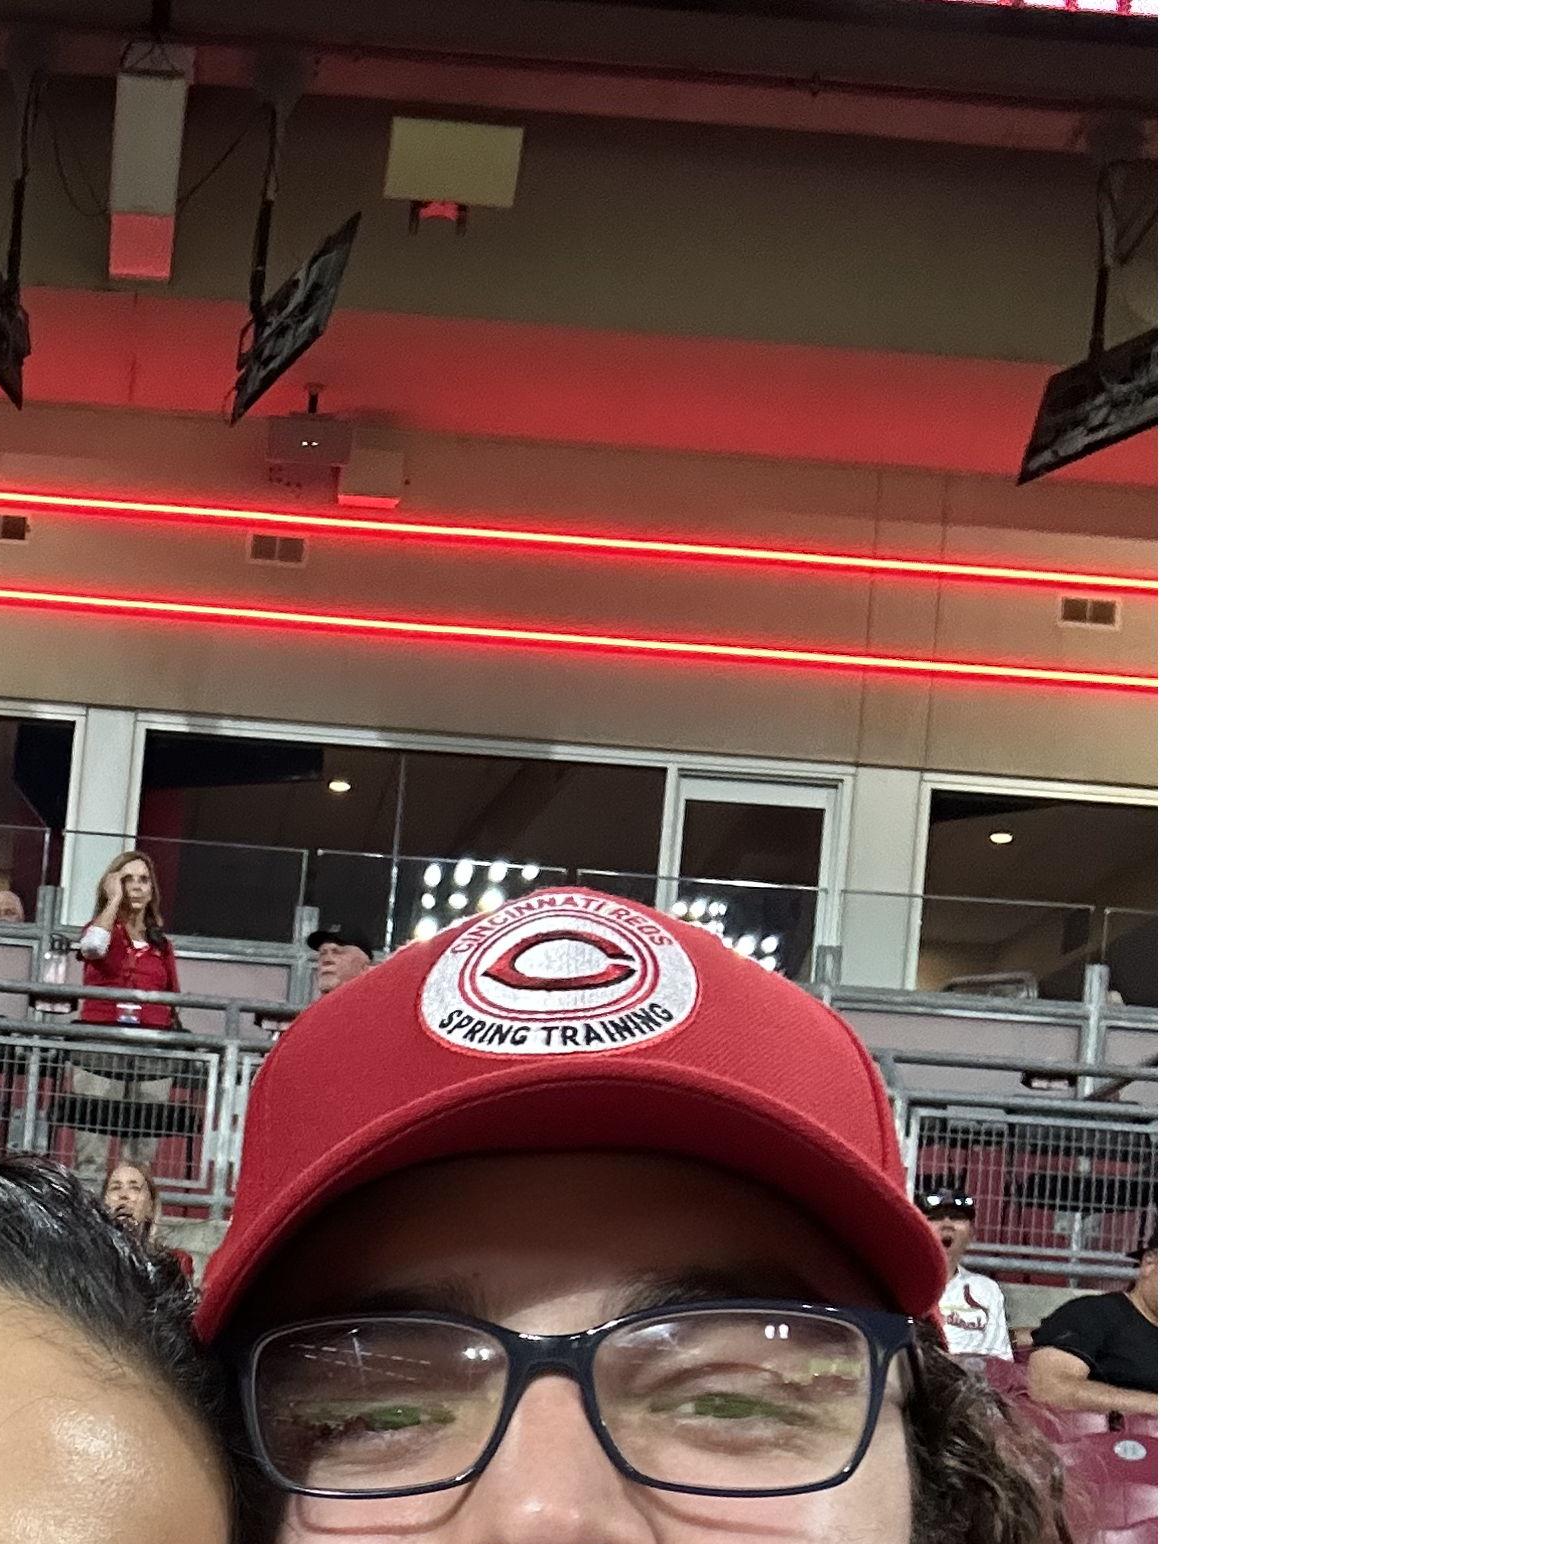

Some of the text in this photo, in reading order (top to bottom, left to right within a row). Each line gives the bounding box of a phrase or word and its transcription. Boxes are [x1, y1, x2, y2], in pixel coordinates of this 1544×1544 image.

[451, 896, 673, 953] CINCINNATI REDS
[438, 1003, 675, 1047] SPRING TRAINING
